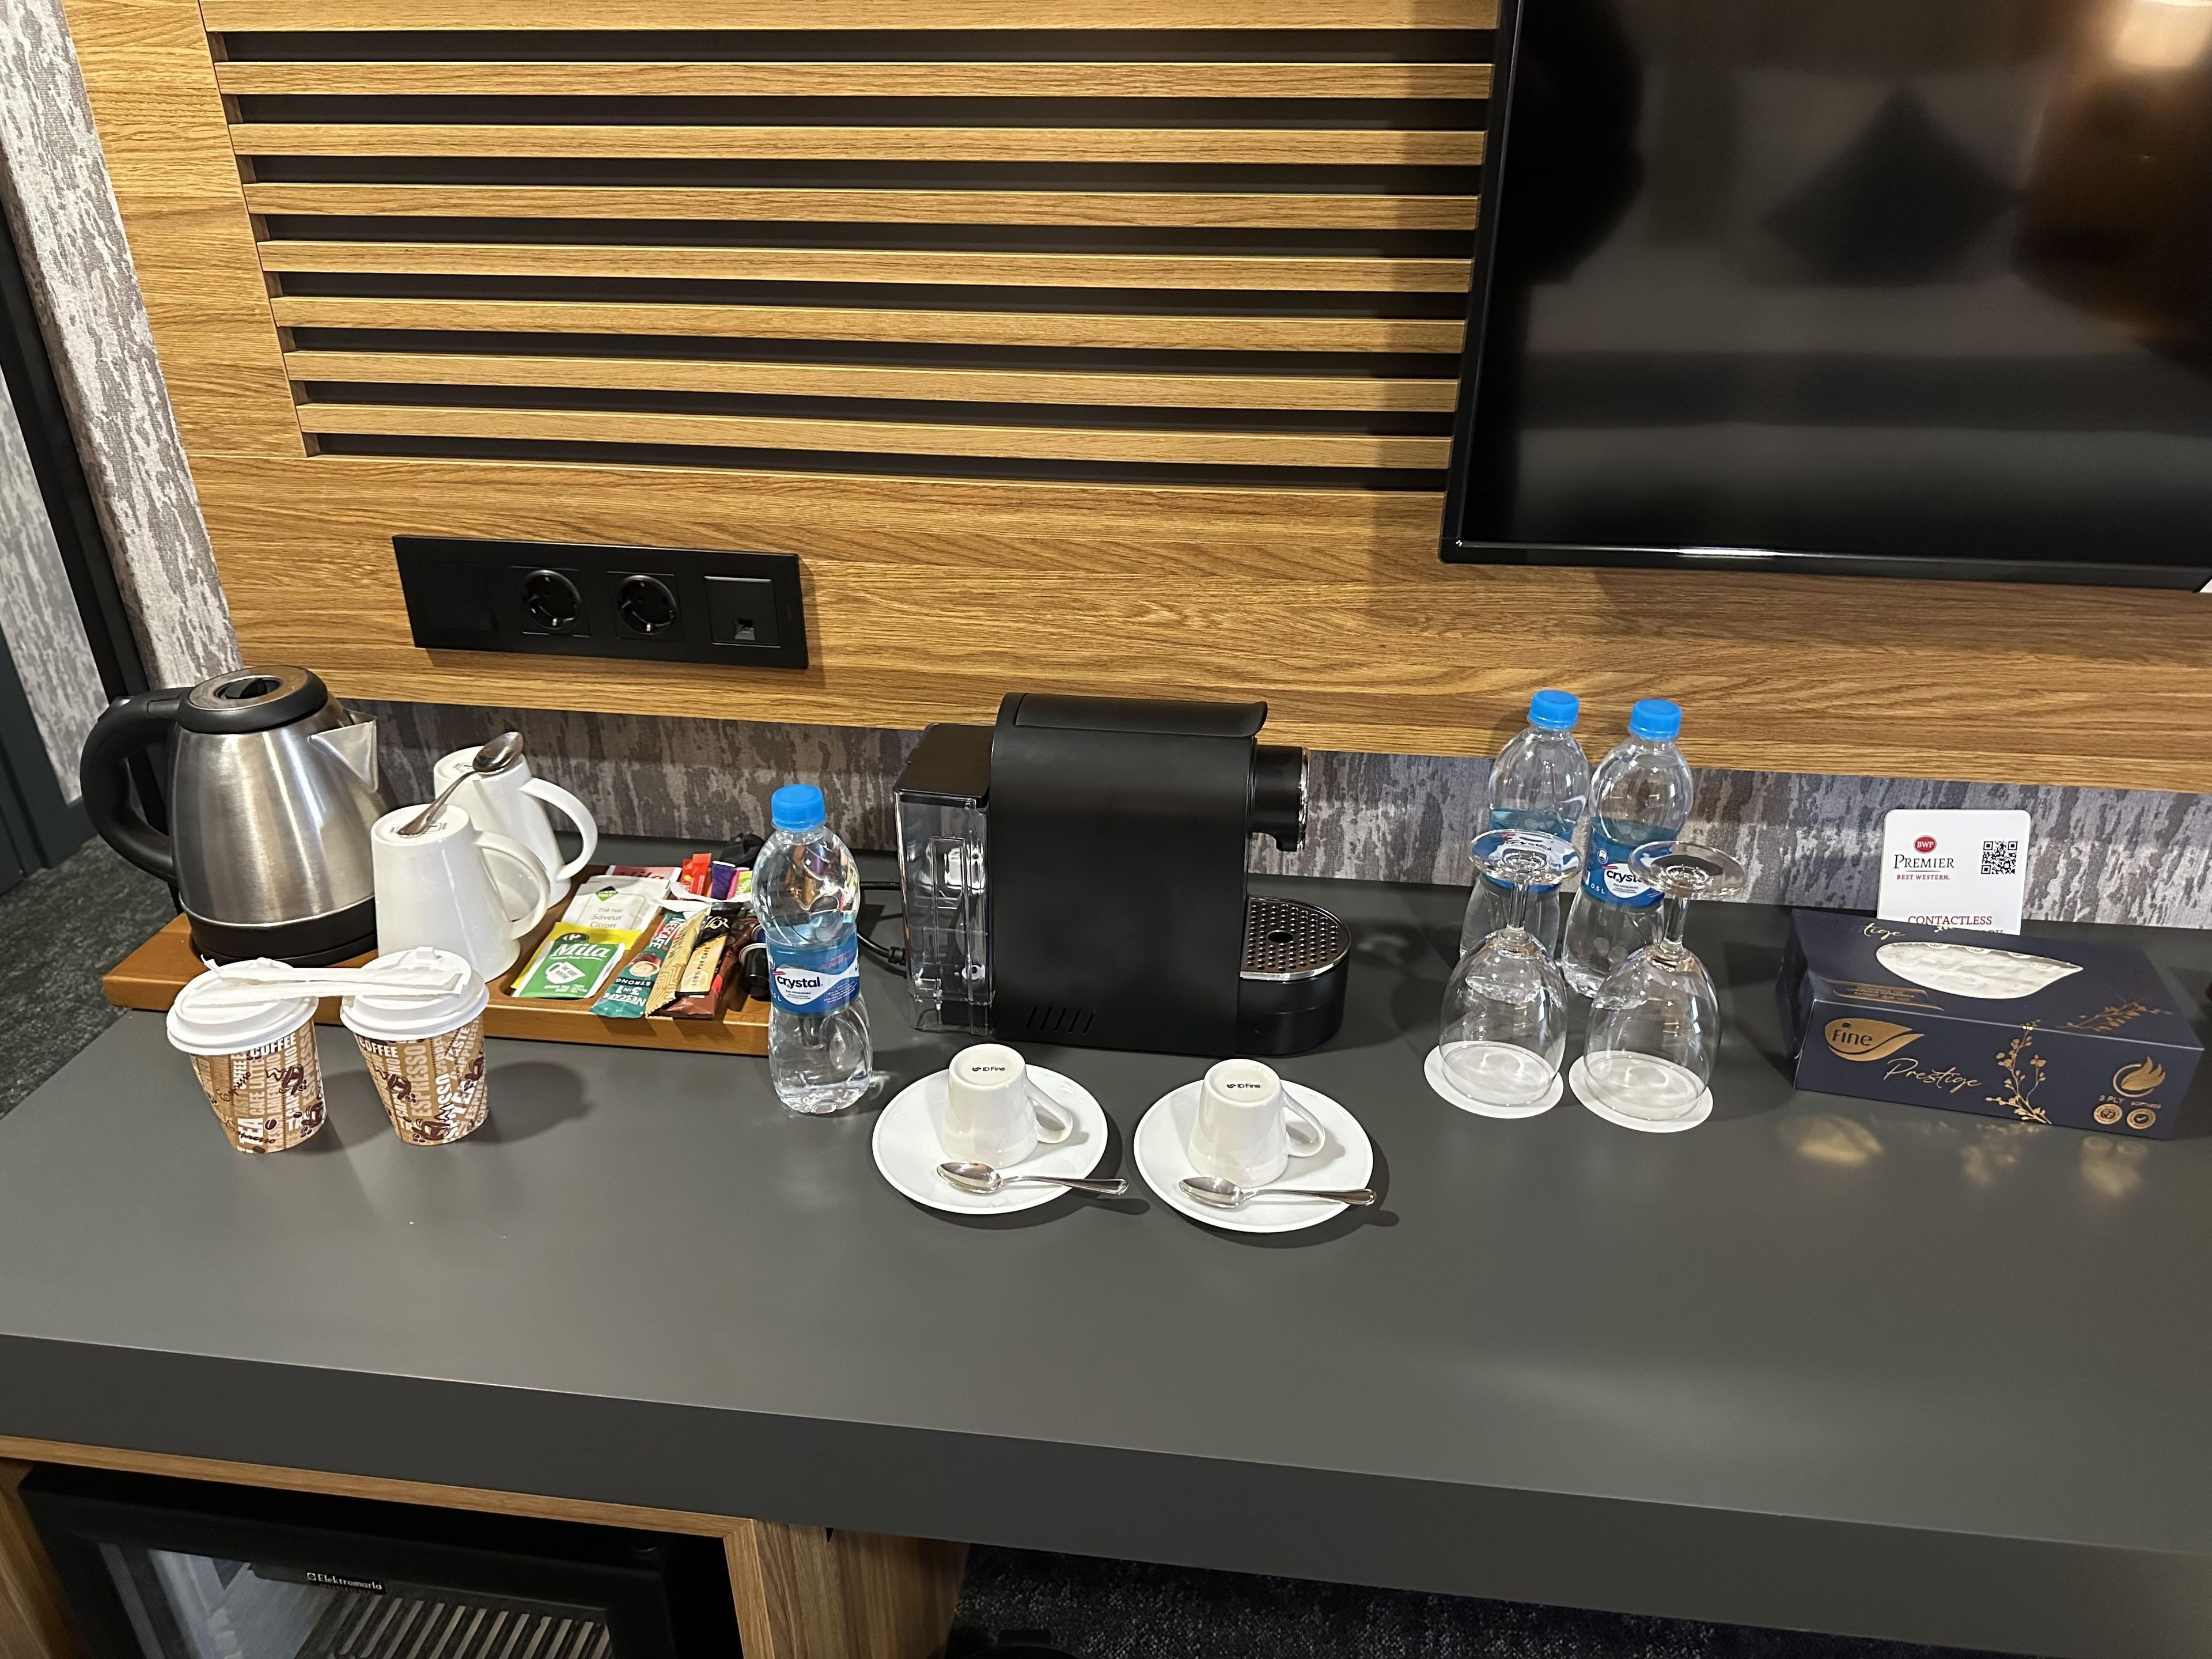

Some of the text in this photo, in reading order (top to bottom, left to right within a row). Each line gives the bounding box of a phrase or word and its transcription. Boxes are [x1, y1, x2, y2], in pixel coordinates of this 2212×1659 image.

[1893, 854, 1955, 869] PREMIER
[1908, 916, 1993, 925] CONTACTLESS
[550, 944, 611, 957] Mila
[615, 978, 652, 986] STRONG
[777, 976, 820, 988] crystal
[251, 1033, 297, 1056] COFFEE
[358, 1038, 399, 1058] COFFEE
[404, 1045, 432, 1116] ESPRESSO
[1884, 1058, 1982, 1093] Prestige
[249, 1058, 266, 1116] CAFE LATTE
[2107, 1096, 2126, 1104] PLY
[237, 1118, 263, 1146] TEA
[317, 1573, 383, 1590] Elektromarla
